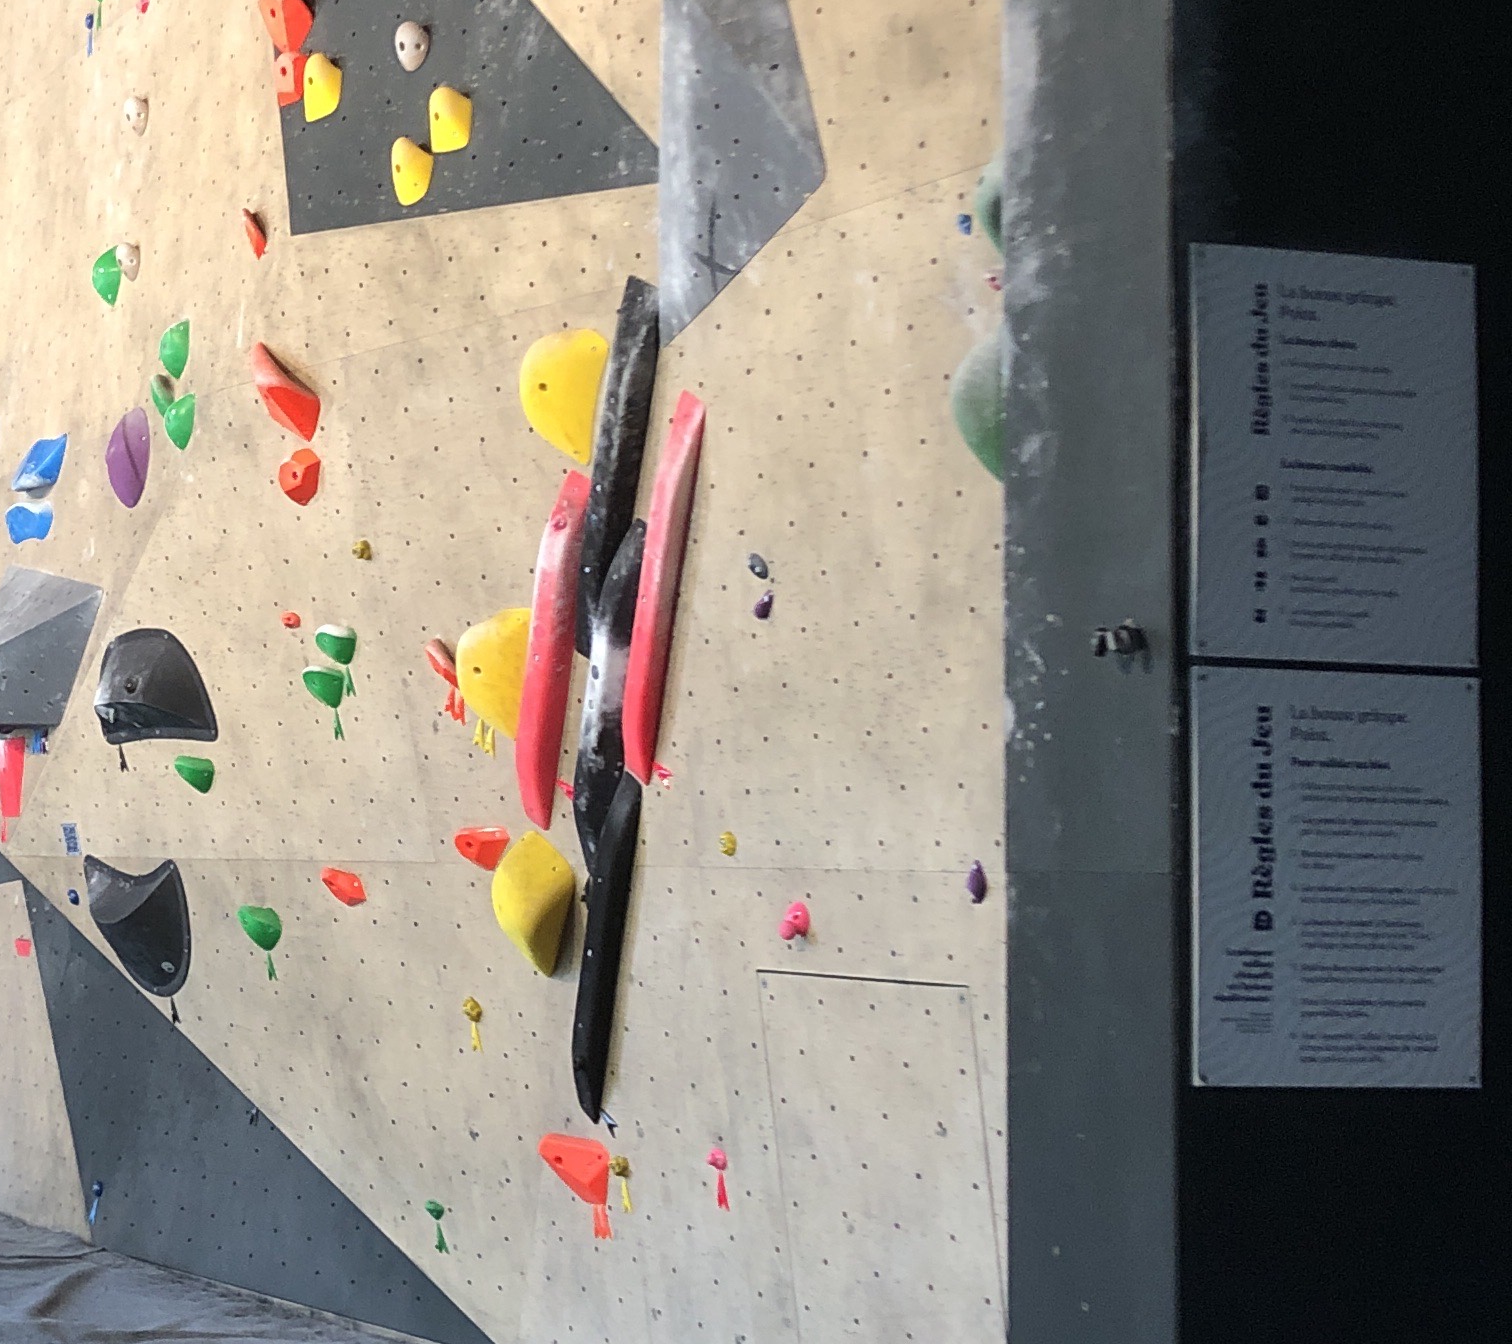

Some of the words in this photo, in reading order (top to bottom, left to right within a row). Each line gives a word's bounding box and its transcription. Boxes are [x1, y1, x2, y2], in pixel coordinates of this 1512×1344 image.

[1250, 706, 1273, 757] Jeu
[1250, 762, 1274, 799] du
[1250, 805, 1276, 900] Règles
